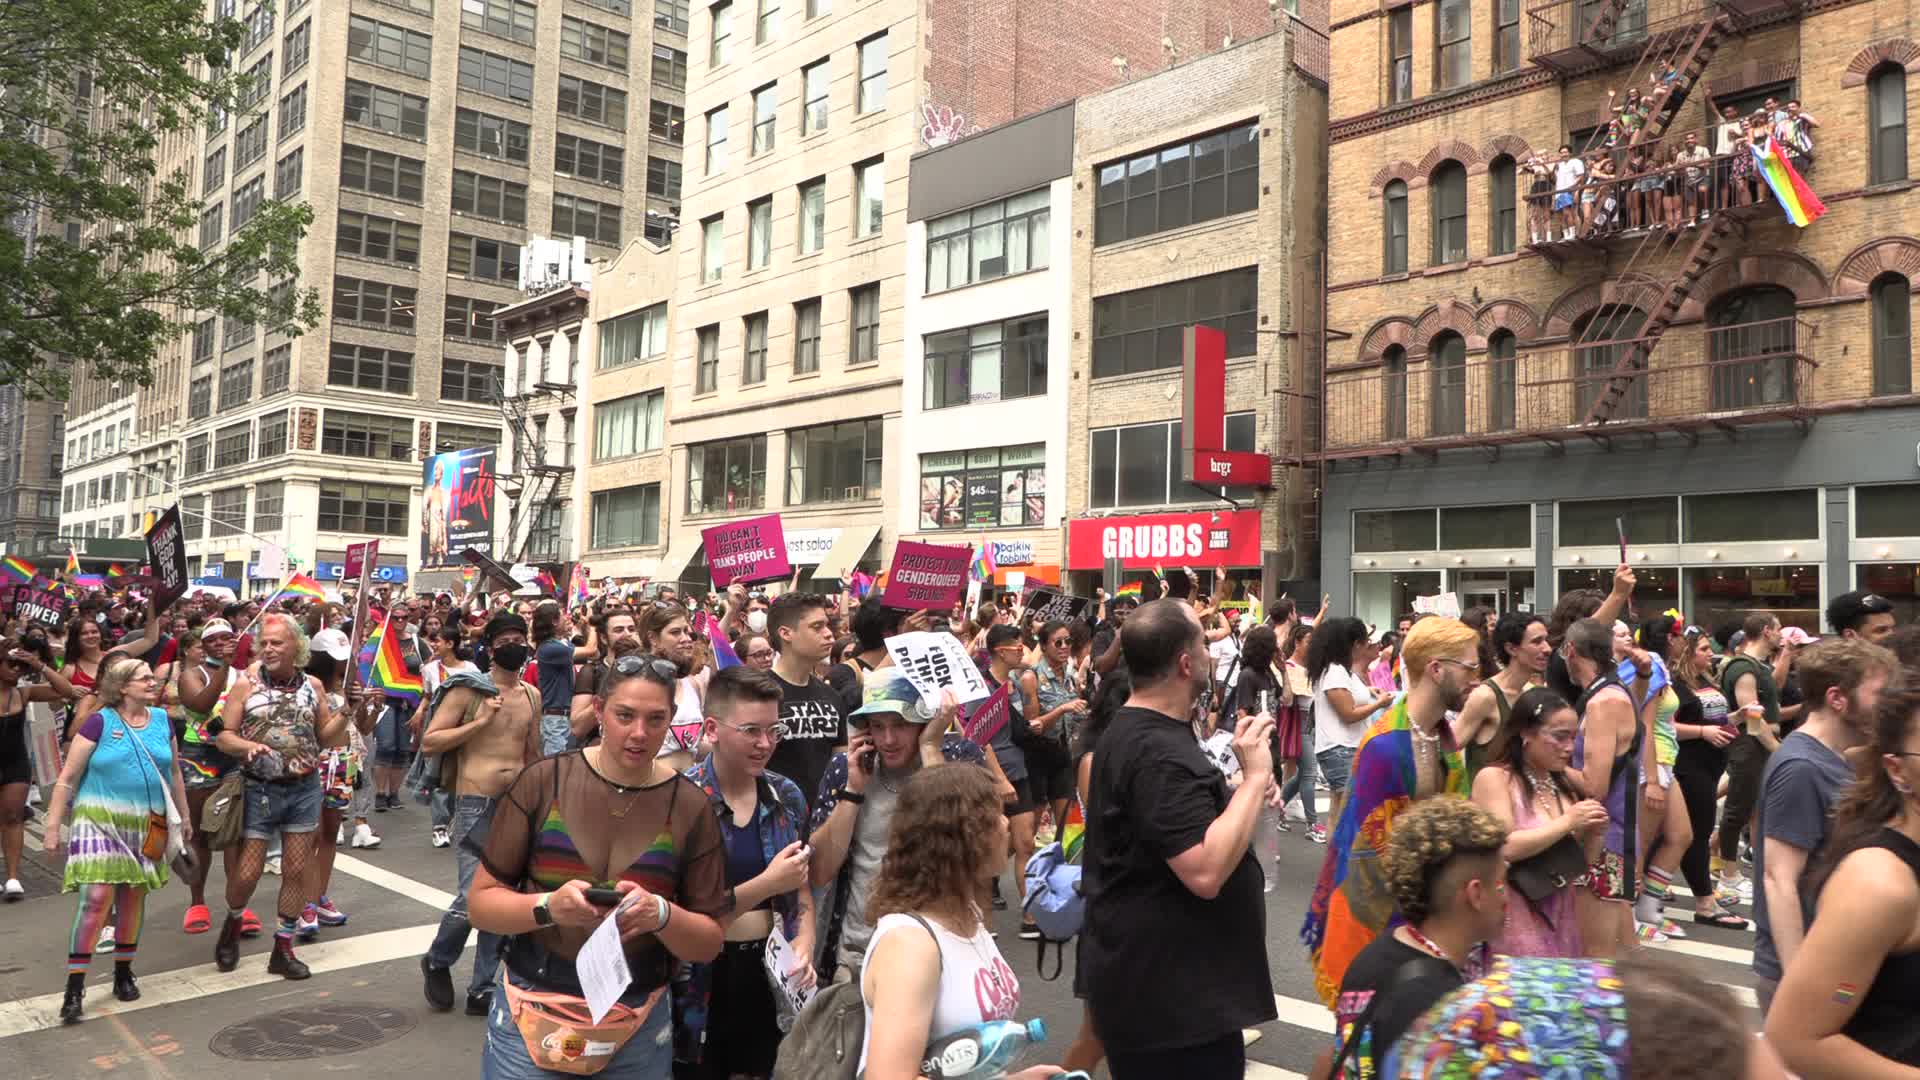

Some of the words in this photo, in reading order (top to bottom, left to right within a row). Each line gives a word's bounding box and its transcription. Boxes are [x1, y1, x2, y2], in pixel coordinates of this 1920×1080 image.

[1210, 457, 1231, 476] brgr
[449, 456, 494, 521] Hacks
[970, 485, 986, 496] $45
[152, 522, 178, 556] THANK
[715, 537, 764, 557] LEGISLATE
[806, 536, 833, 551] salad
[1102, 523, 1203, 559] GRUBBS
[1209, 539, 1228, 548] AWAY
[159, 542, 175, 566] GOD
[712, 555, 736, 569] TRANS
[737, 547, 776, 566] PEOPLE
[901, 552, 944, 572] PROTECT
[163, 568, 178, 588] AY!
[896, 569, 961, 587] GENDERQUEER
[17, 588, 65, 612] DYKE
[1039, 603, 1072, 616] ARE
[1049, 594, 1074, 606] WE
[16, 602, 60, 625] POWER
[914, 654, 935, 684] THE
[929, 646, 953, 689] FUCK
[780, 701, 838, 718] STAR
[973, 697, 1004, 737] BINARY
[779, 717, 839, 740] WARS
